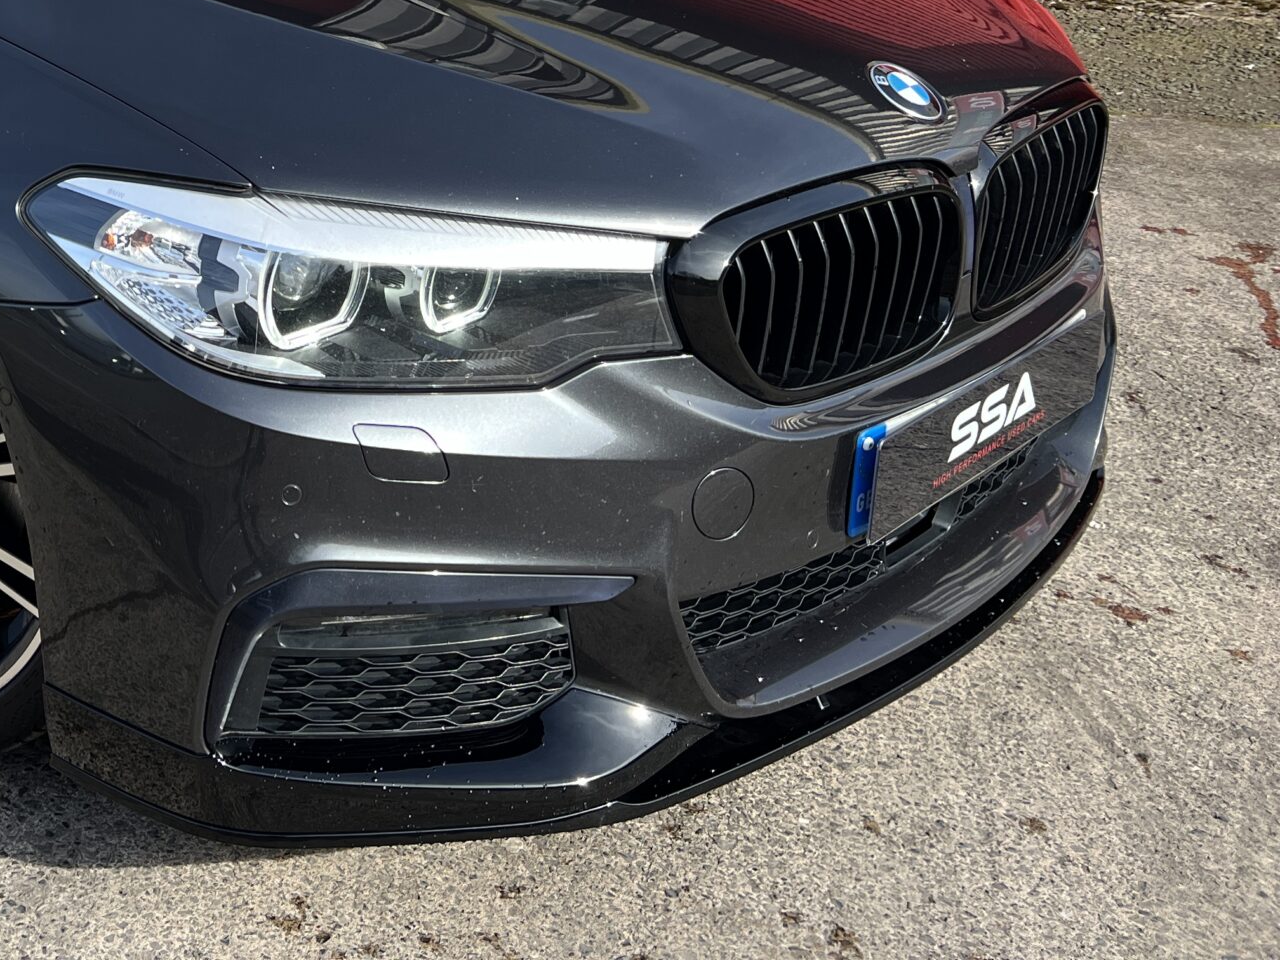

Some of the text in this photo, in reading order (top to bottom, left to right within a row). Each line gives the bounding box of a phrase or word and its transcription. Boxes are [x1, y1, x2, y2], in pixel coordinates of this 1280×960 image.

[932, 409, 1046, 488] HIGH PERFORMANCE USED CARS
[947, 372, 1036, 463] SSA
